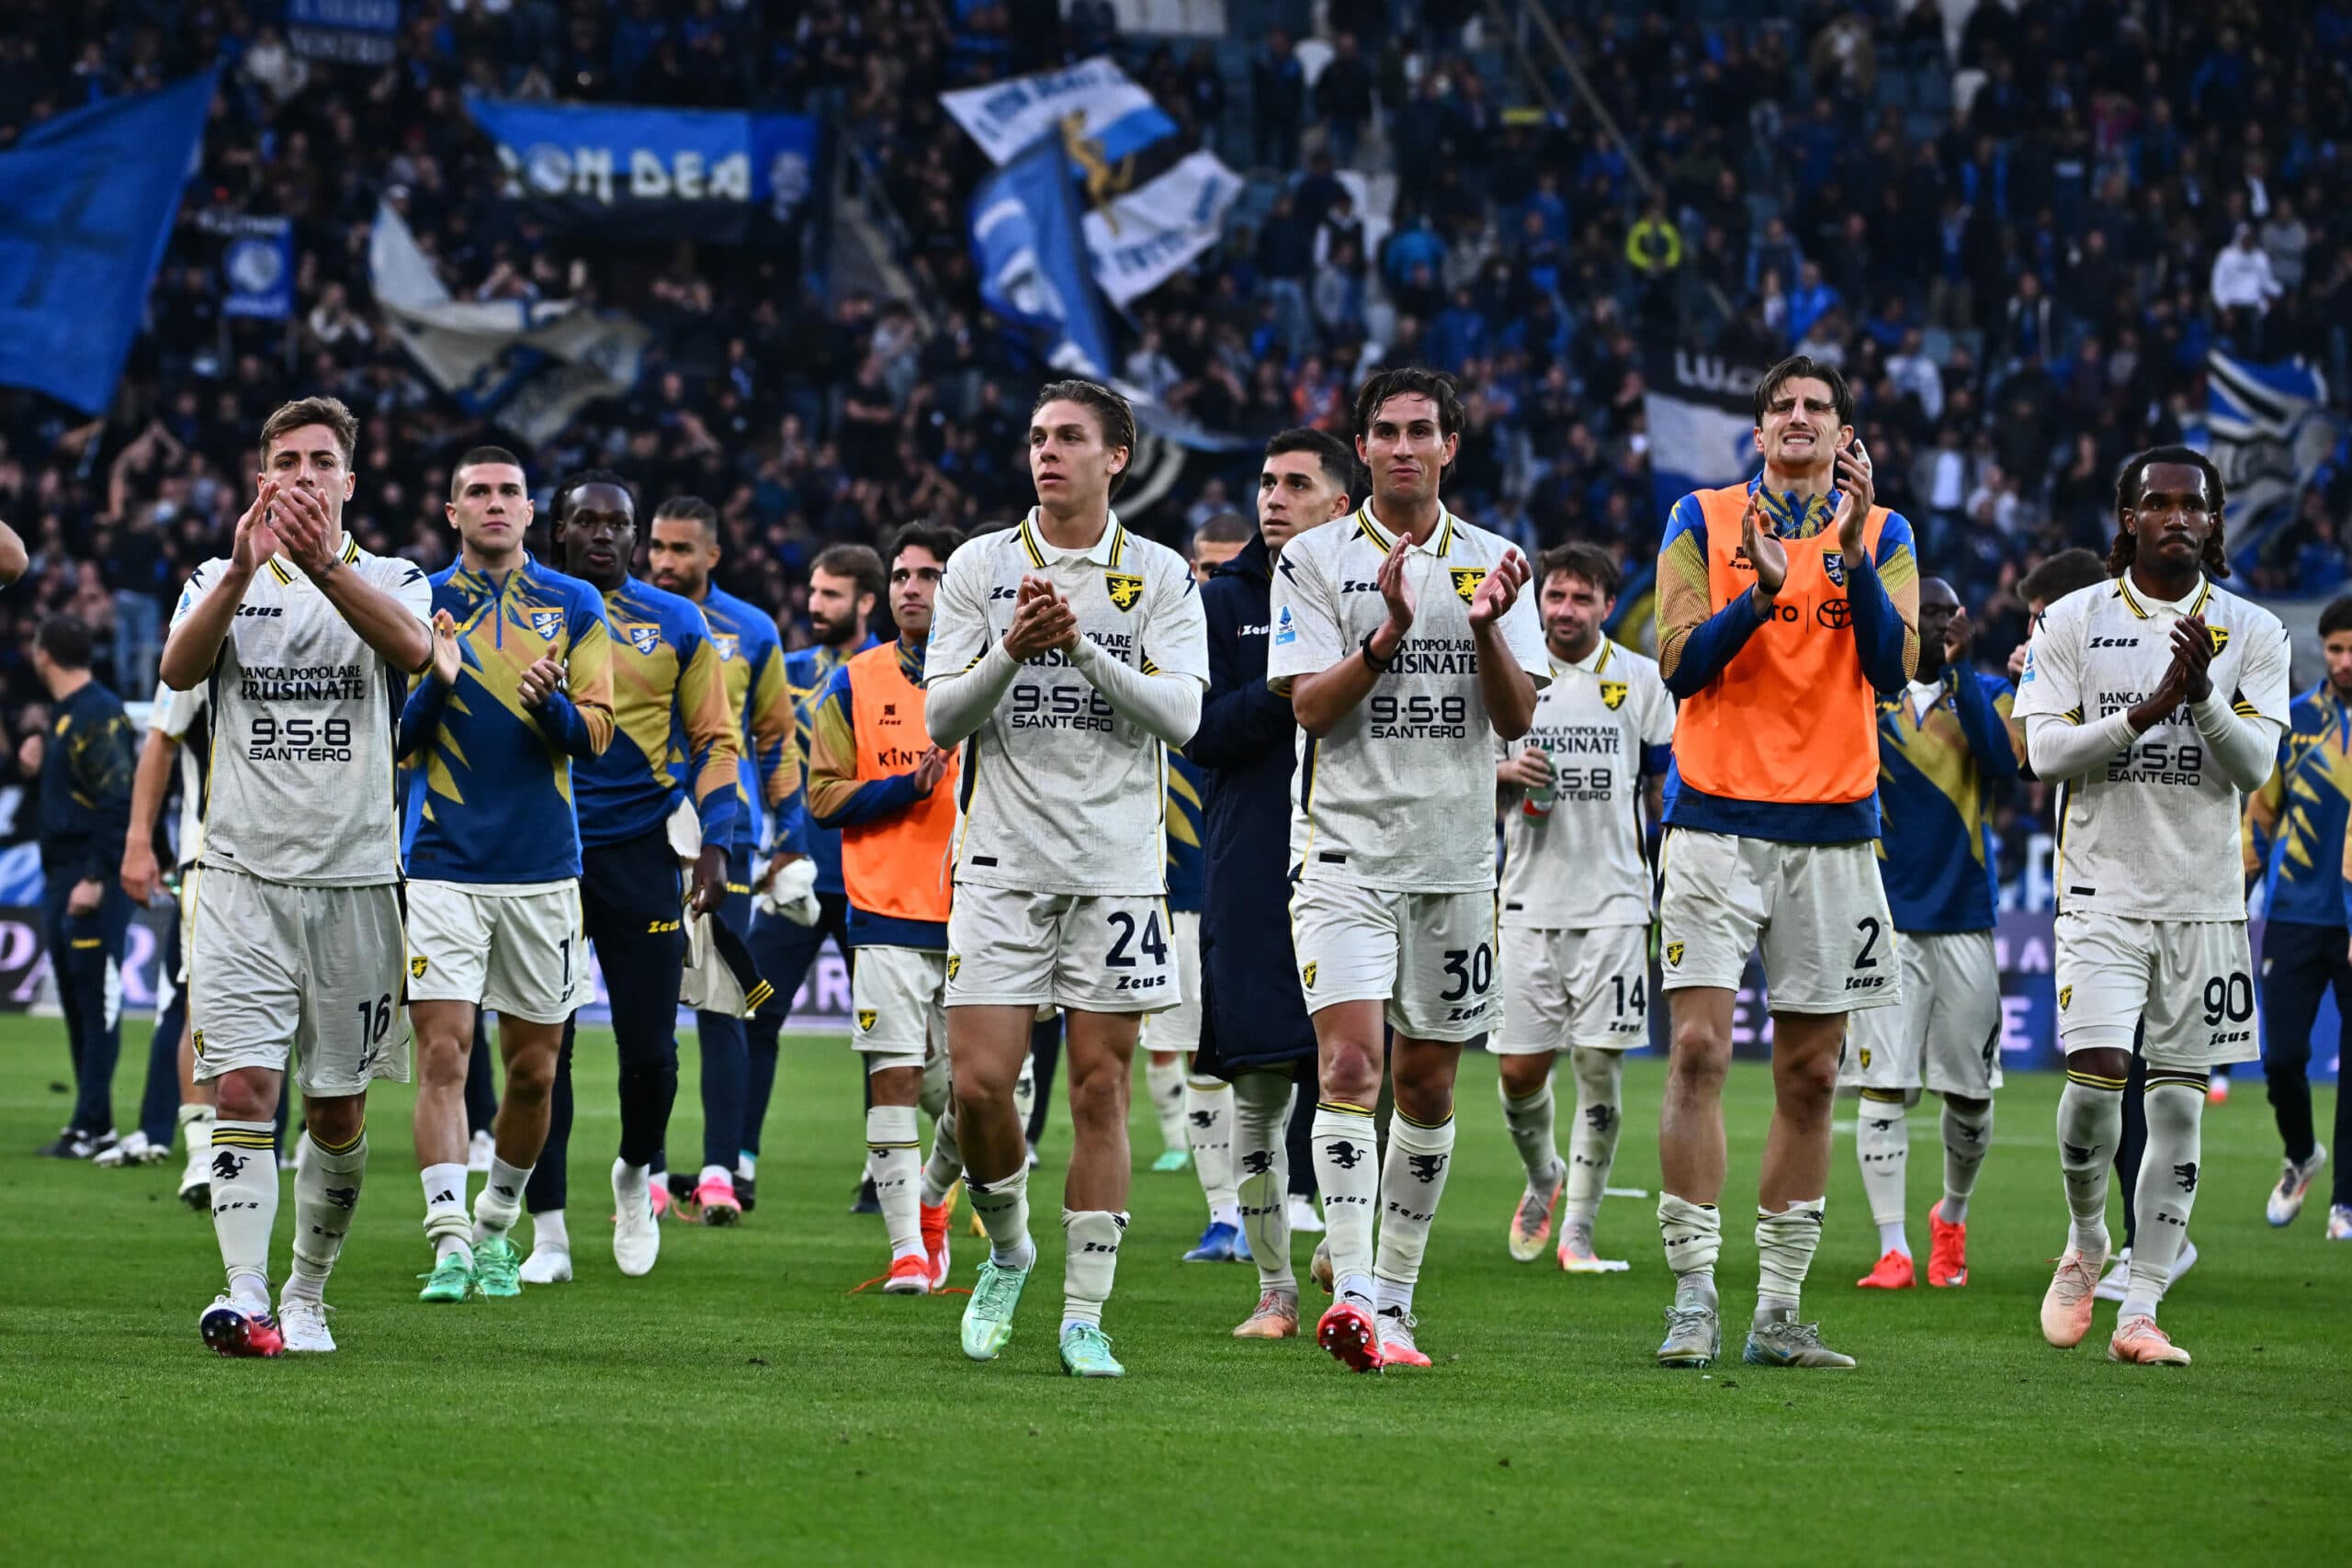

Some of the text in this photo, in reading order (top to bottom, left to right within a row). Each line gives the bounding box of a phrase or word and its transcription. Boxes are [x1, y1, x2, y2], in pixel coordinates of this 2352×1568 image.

[1341, 581, 1381, 593] Zeu
[234, 604, 283, 617] Zeus
[2089, 637, 2139, 649] Zeus
[289, 665, 361, 681] POPOLARE
[242, 680, 365, 701] FRUSINATE
[2099, 692, 2143, 705] BANCA
[1012, 716, 1114, 733] SANTERO
[1371, 725, 1466, 739] SANTERO
[1529, 727, 1560, 736] ANCA
[249, 748, 352, 761] SANTERO
[2108, 770, 2200, 786] SANTERO
[1105, 910, 1168, 967] 24
[1854, 917, 1880, 970] 2
[1440, 942, 1492, 1001] 30
[1115, 976, 1167, 990] Zeus
[1845, 976, 1884, 990] Zeus
[1611, 976, 1645, 1017] 14
[2204, 972, 2253, 1026] 90
[1447, 1001, 1487, 1021] Zeus
[358, 993, 392, 1054] 16
[2209, 1031, 2250, 1045] Zeus
[1326, 1196, 1367, 1206] Zeus
[1389, 1201, 1434, 1222] Zeus
